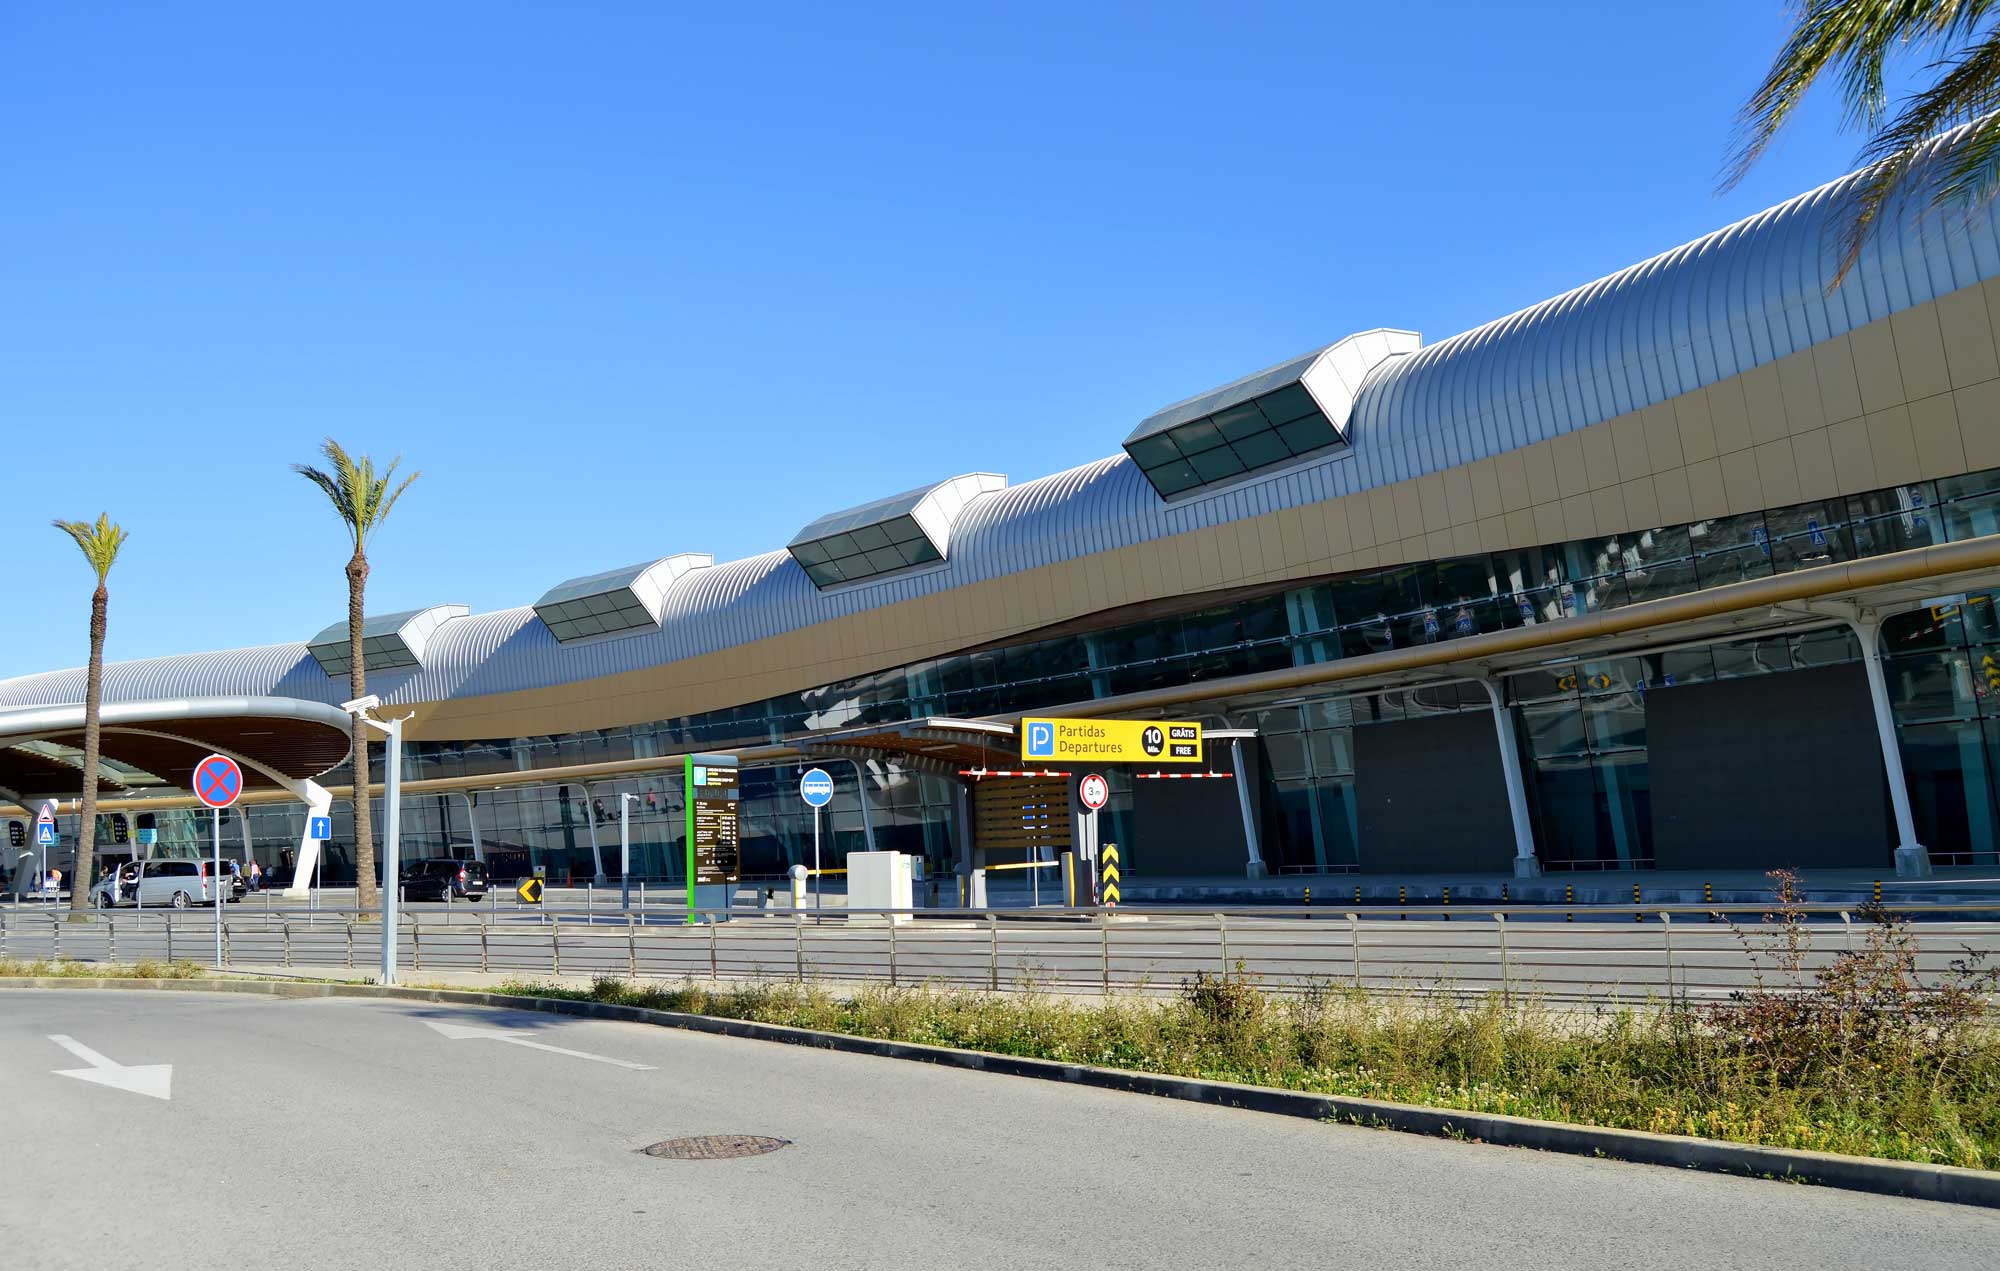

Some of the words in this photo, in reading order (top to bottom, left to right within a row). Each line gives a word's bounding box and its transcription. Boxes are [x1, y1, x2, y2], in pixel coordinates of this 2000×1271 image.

[1059, 725, 1105, 738] Partidas
[1145, 729, 1161, 744] 10
[1171, 728, 1195, 738] GRÁTIS
[1032, 726, 1049, 752] P
[1059, 740, 1122, 756] Departures
[1175, 746, 1192, 755] FREE
[1088, 787, 1094, 796] 3
